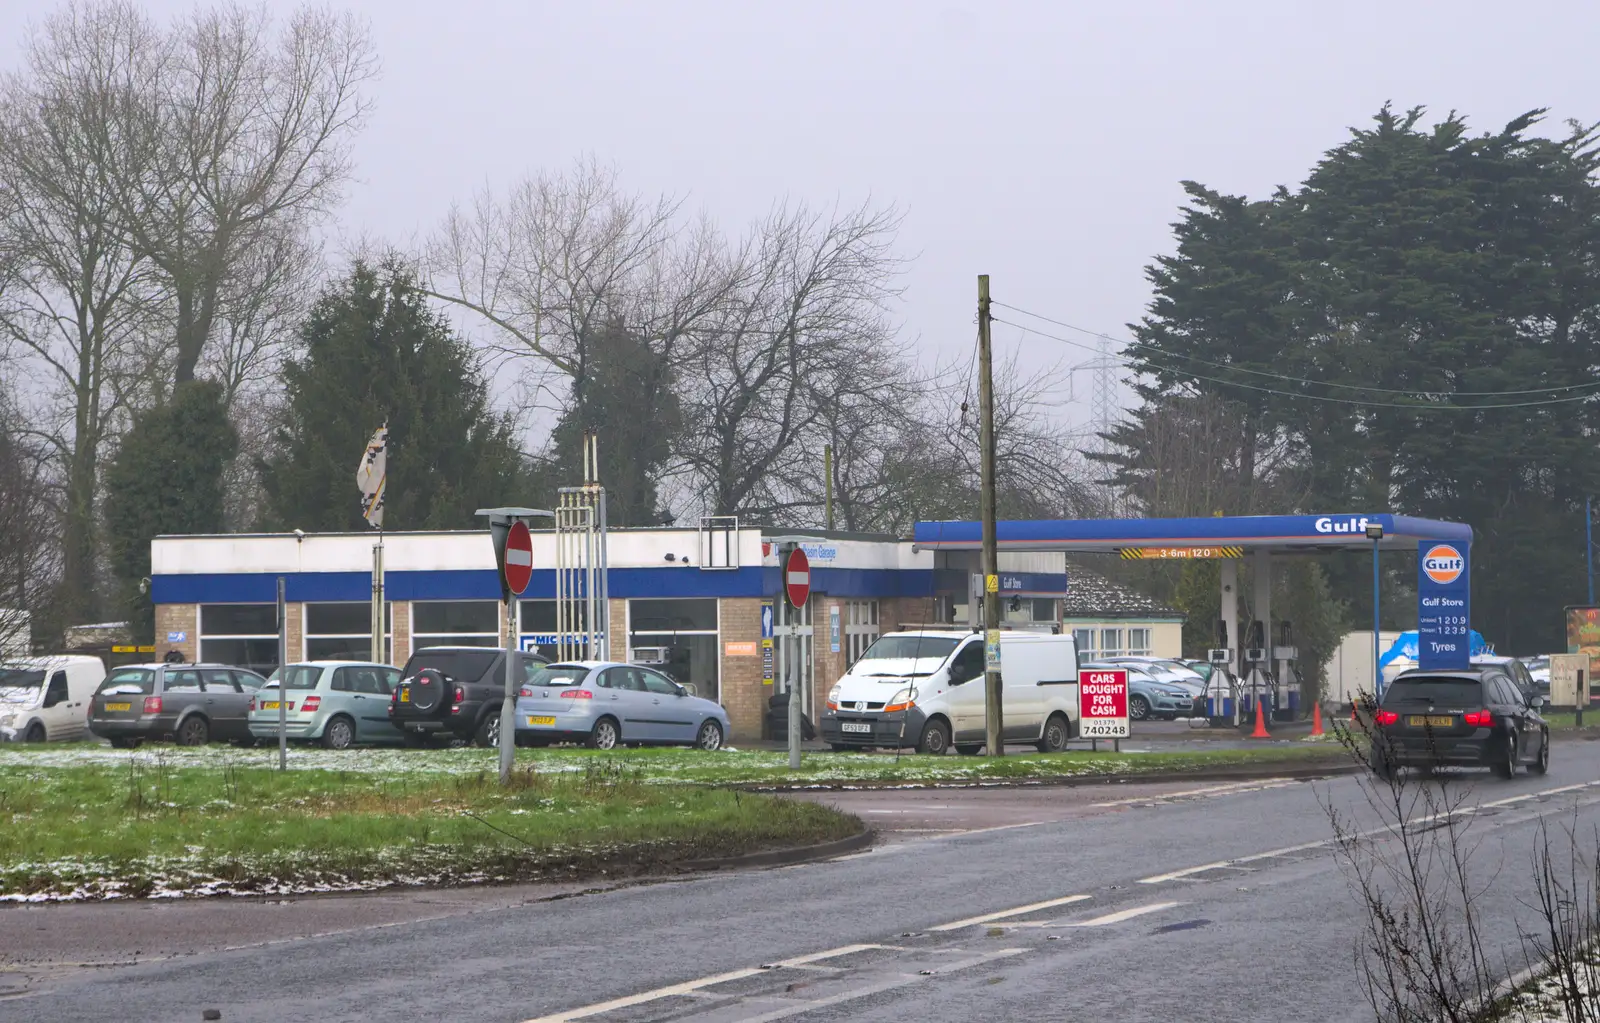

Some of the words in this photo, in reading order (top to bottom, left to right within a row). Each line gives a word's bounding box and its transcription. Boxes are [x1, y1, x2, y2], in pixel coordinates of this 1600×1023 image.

[1315, 517, 1369, 533] Gulf
[1426, 559, 1461, 570] Gulf
[1422, 598, 1439, 606] Gulf
[1441, 598, 1464, 606] Store
[1430, 642, 1456, 653] Tyres
[1090, 674, 1115, 684] CARS
[1082, 684, 1124, 694] BOUGHT
[1093, 695, 1113, 705] FOR
[1090, 706, 1116, 715] CASH
[1083, 726, 1126, 735] 740248
